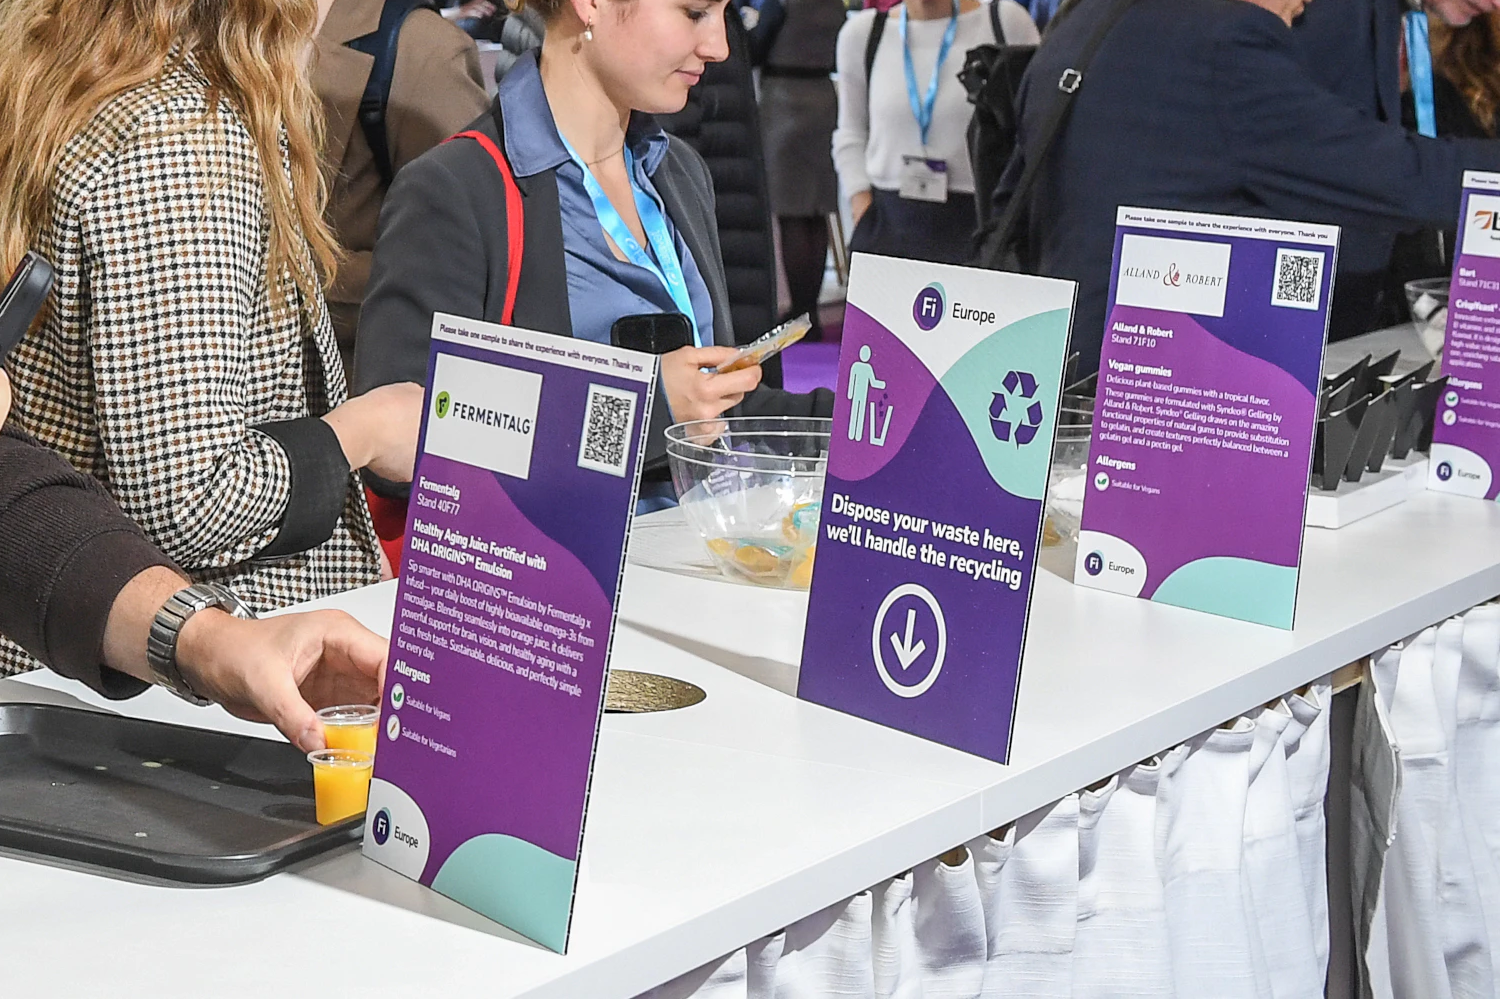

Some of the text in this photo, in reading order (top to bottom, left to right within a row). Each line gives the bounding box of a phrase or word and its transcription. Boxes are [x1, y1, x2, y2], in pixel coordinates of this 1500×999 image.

[1123, 267, 1160, 280] ALLAND
[1185, 273, 1224, 287] ROBERT
[921, 296, 996, 325] Fi Europe
[1111, 333, 1157, 348] Stand 71F10
[1112, 321, 1174, 339] Alland & Robert
[439, 323, 457, 335] Please
[457, 328, 470, 338] take
[469, 331, 481, 340] one
[480, 333, 501, 344] sample
[501, 336, 508, 345] to
[508, 338, 524, 349] share
[524, 341, 535, 351] the
[535, 344, 566, 357] experience
[567, 351, 581, 360] with
[611, 357, 631, 370] Thank
[631, 364, 643, 373] you
[1108, 358, 1173, 378] Vegan gummies
[452, 401, 531, 435] FERMENTALG
[1095, 454, 1136, 471] Allergens
[419, 475, 461, 501] Fermentalg
[416, 492, 461, 516] Stand 40F77
[831, 493, 1024, 561] Dispose your waste here,
[413, 517, 547, 572] Healthy Aging Juice Fortified with
[826, 524, 1022, 591] we'll handle the recycling
[410, 536, 430, 555] DHA
[474, 556, 513, 581] Emulsion
[1089, 556, 1135, 575] Fi Europe
[393, 659, 431, 685] Allergens
[377, 817, 419, 849] Fi Europe
